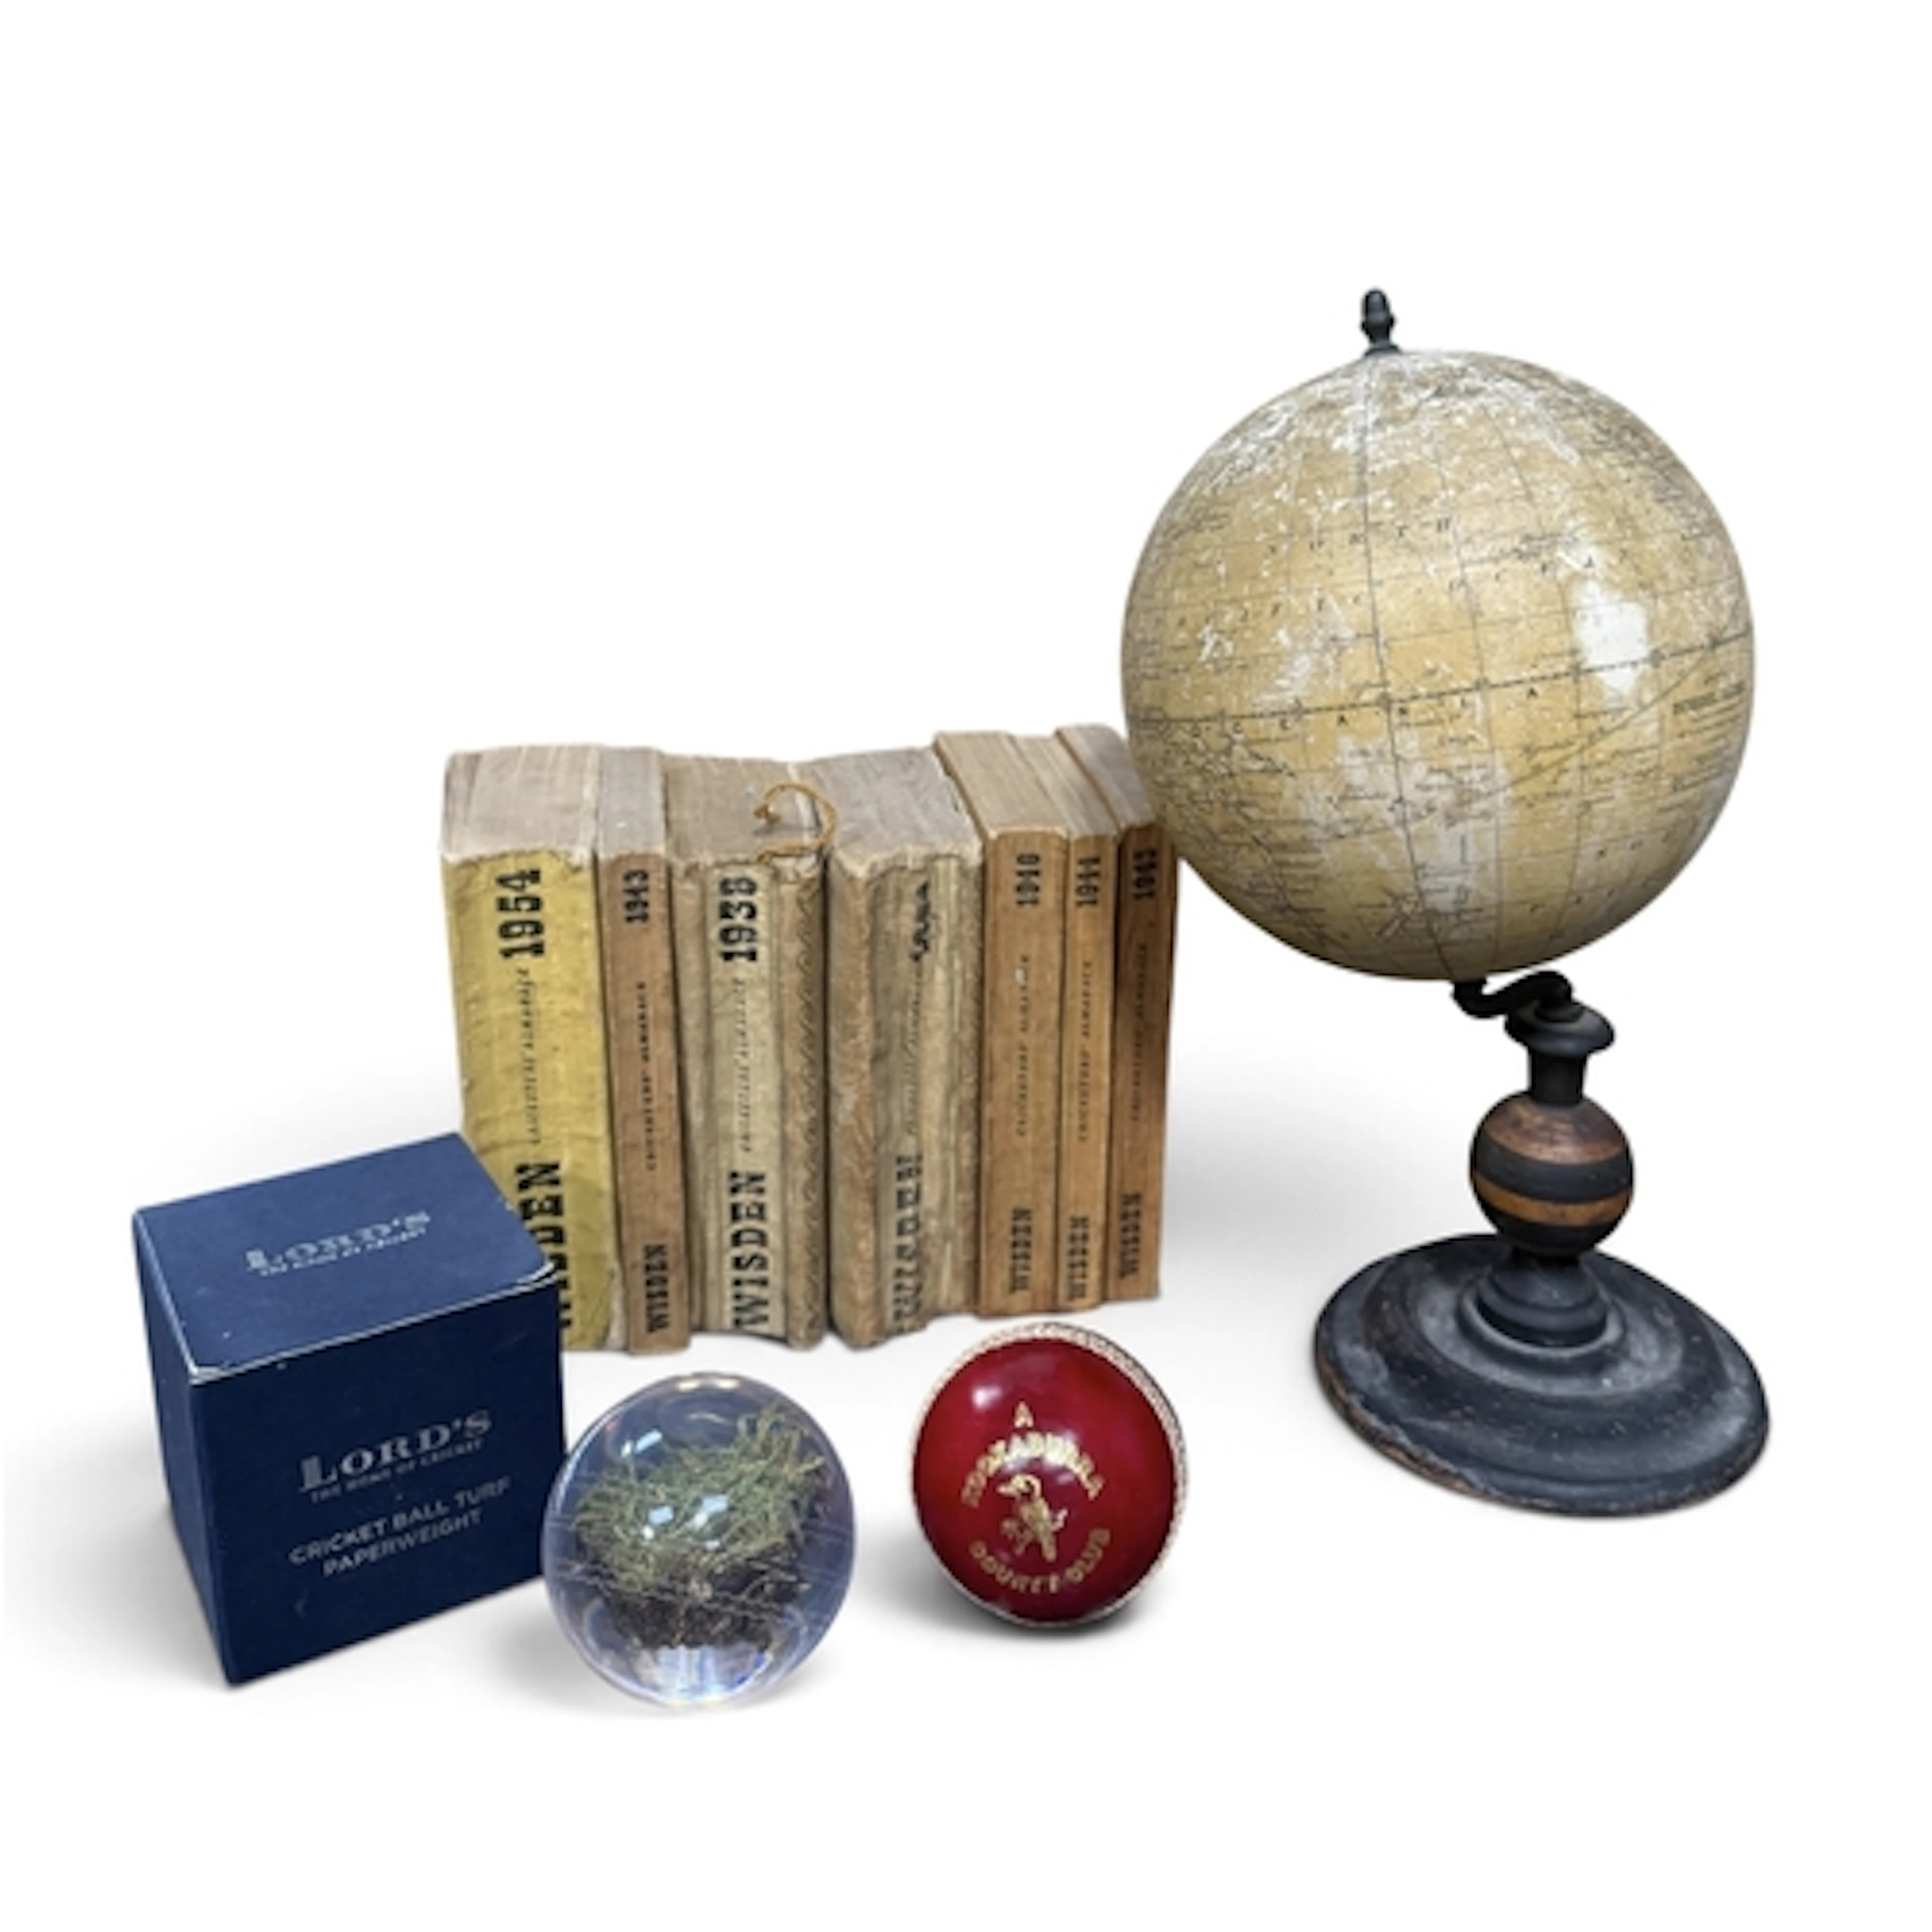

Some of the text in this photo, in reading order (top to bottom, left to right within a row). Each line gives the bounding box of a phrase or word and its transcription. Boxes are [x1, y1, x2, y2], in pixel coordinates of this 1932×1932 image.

[496, 869, 545, 959] 1954
[623, 869, 650, 925] 1943
[720, 876, 758, 962] 1938
[1075, 856, 1101, 907] 1944
[246, 1211, 431, 1273] LORD'S
[729, 1171, 769, 1330] WISDEN
[1011, 1208, 1032, 1294] WISDEN
[1067, 1215, 1089, 1301] WISDEN
[1120, 1193, 1142, 1278] WISDEN
[644, 1245, 668, 1333] WISDEN
[298, 1408, 494, 1493] LORD'S
[1013, 1401, 1035, 1428] A
[288, 1475, 512, 1565] CRICKET BALL TURF
[321, 1509, 481, 1578] PAPERWEIGHT
